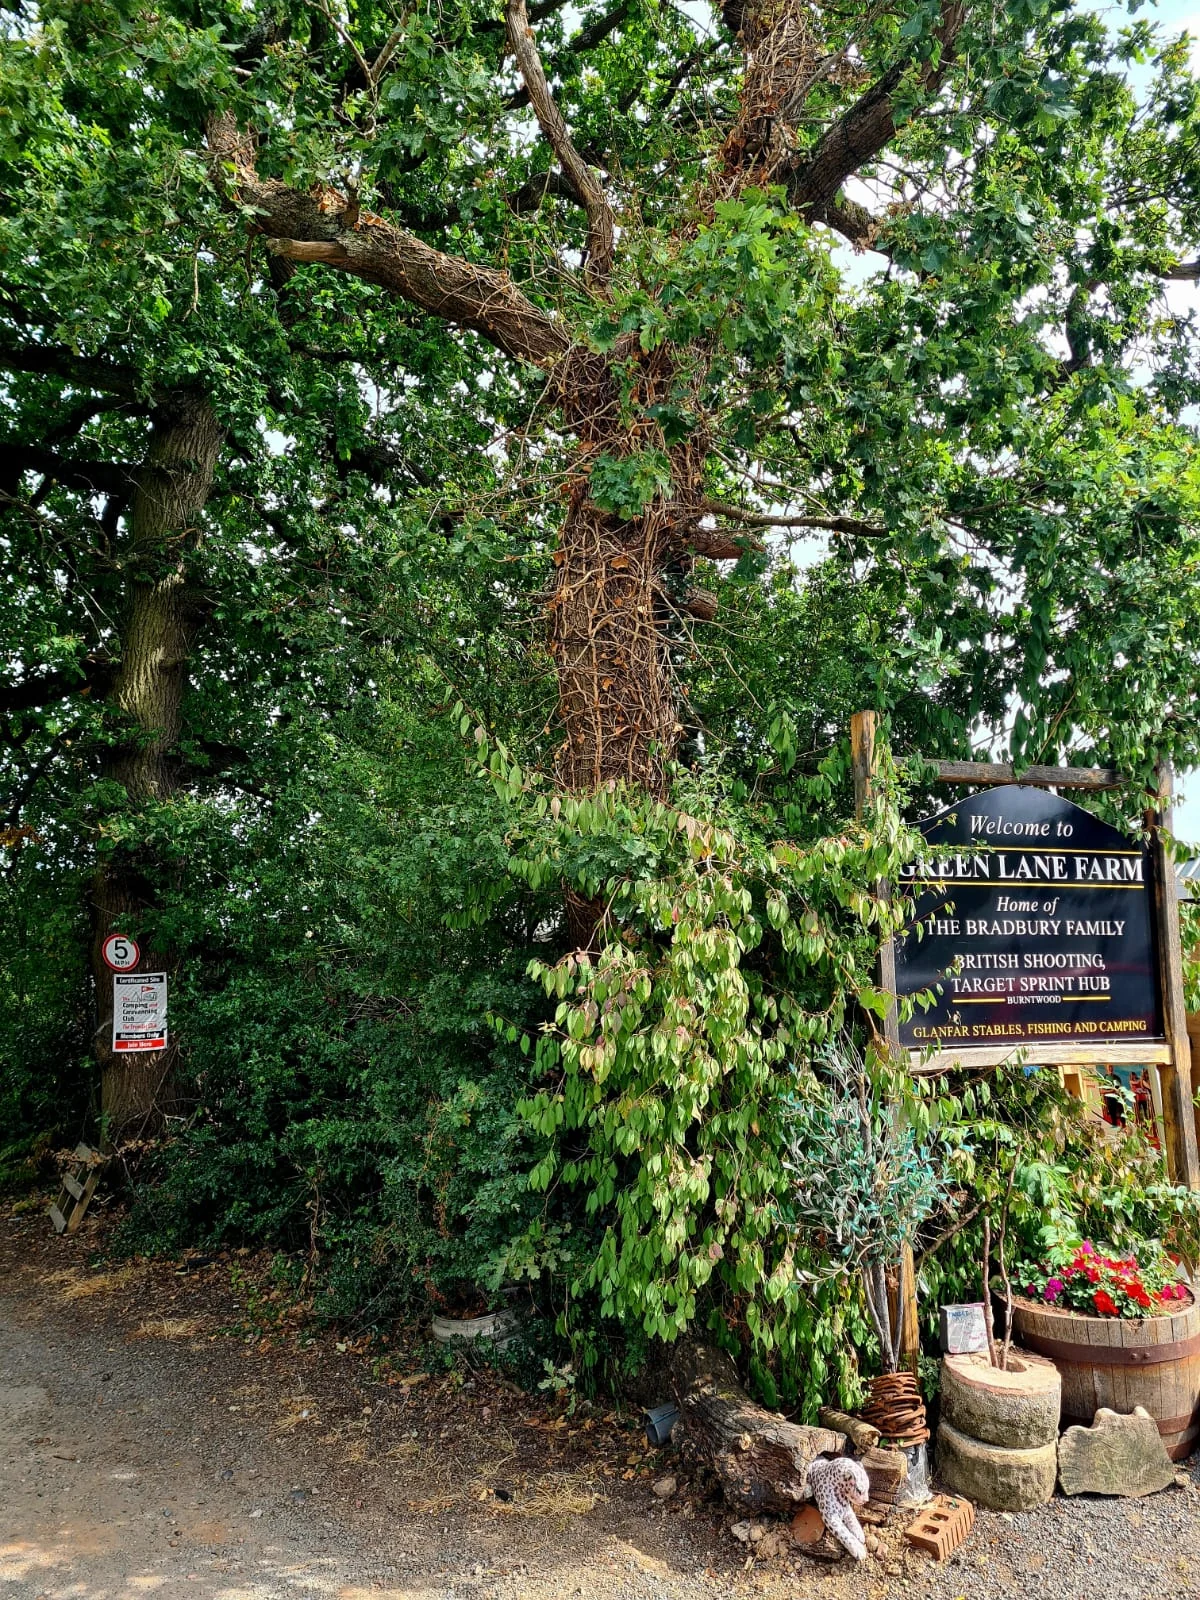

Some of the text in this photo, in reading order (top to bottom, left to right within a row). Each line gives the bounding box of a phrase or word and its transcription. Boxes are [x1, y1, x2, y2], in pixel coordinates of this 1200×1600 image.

[970, 815, 1074, 838] Welcome to
[998, 854, 1068, 880] LANE
[1073, 856, 1145, 882] FARM
[996, 896, 1060, 916] Home of
[924, 919, 1126, 936] THE BRADBURY FAMILY
[114, 939, 128, 960] 5
[954, 953, 1106, 971] BRITISH SHOOTING,
[951, 976, 1111, 993] TARGET SPRINT HUB
[1007, 995, 1062, 1005] BURNTWOOD
[913, 1020, 1147, 1039] GLANFAR STABLES, FISHING AND CAMPING
